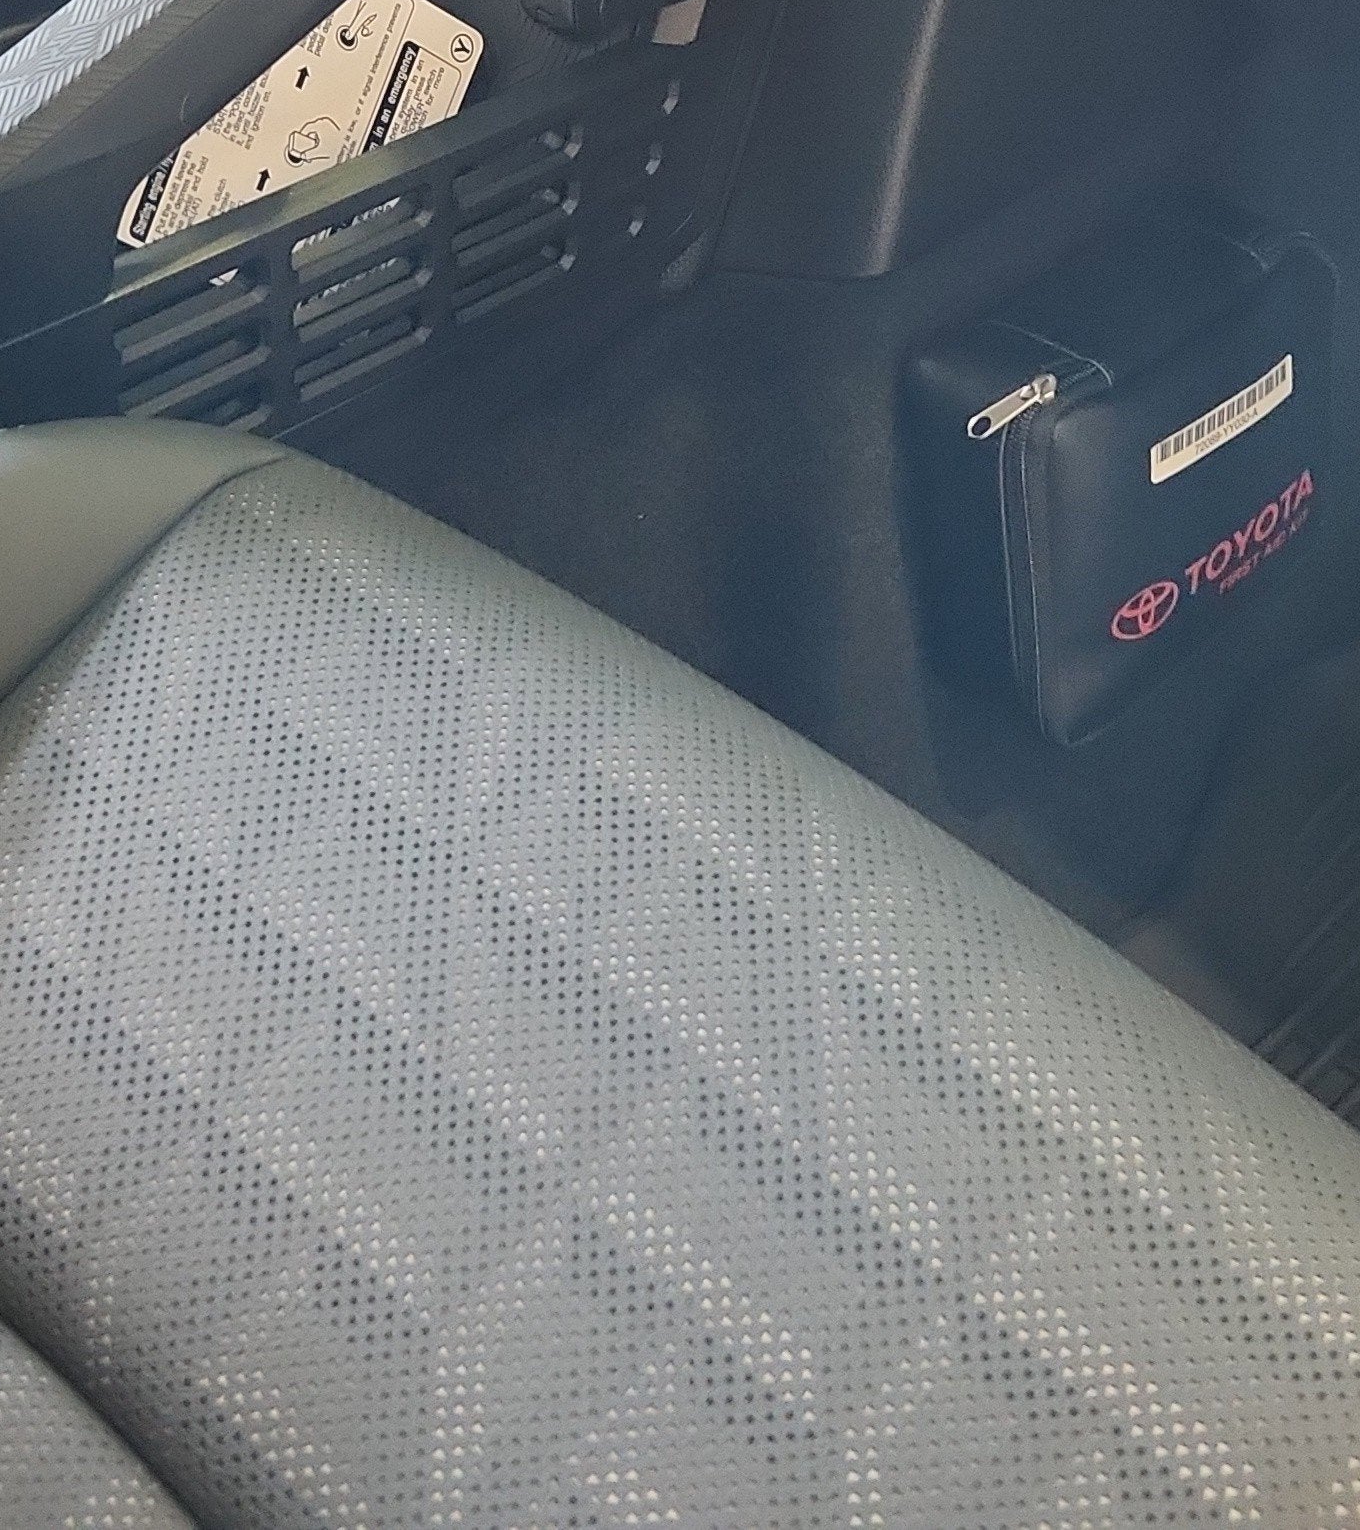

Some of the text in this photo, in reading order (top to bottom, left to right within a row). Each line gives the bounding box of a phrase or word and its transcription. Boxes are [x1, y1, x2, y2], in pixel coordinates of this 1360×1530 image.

[354, 105, 363, 116] or
[360, 74, 374, 97] signal
[369, 32, 390, 75] interference
[385, 2, 402, 33] prevents
[397, 87, 415, 120] system
[409, 73, 418, 84] in
[414, 58, 424, 72] an
[411, 75, 427, 101] press
[421, 67, 437, 96] switch
[431, 65, 445, 90] more
[232, 109, 245, 132] direct
[250, 104, 267, 132] ignition
[371, 124, 385, 138] in
[378, 107, 391, 123] an
[386, 44, 417, 106] emergency
[154, 217, 166, 234] Put
[160, 201, 172, 218] the
[166, 181, 180, 201] shift
[174, 158, 188, 181] lever
[182, 149, 192, 159] in
[166, 210, 178, 228] and
[174, 177, 192, 211] depress
[186, 161, 196, 176] the
[180, 193, 194, 217] pedal
[190, 175, 201, 192] and
[196, 155, 209, 174] hold
[212, 176, 227, 202] clutch
[1184, 468, 1314, 595] TOYOTA
